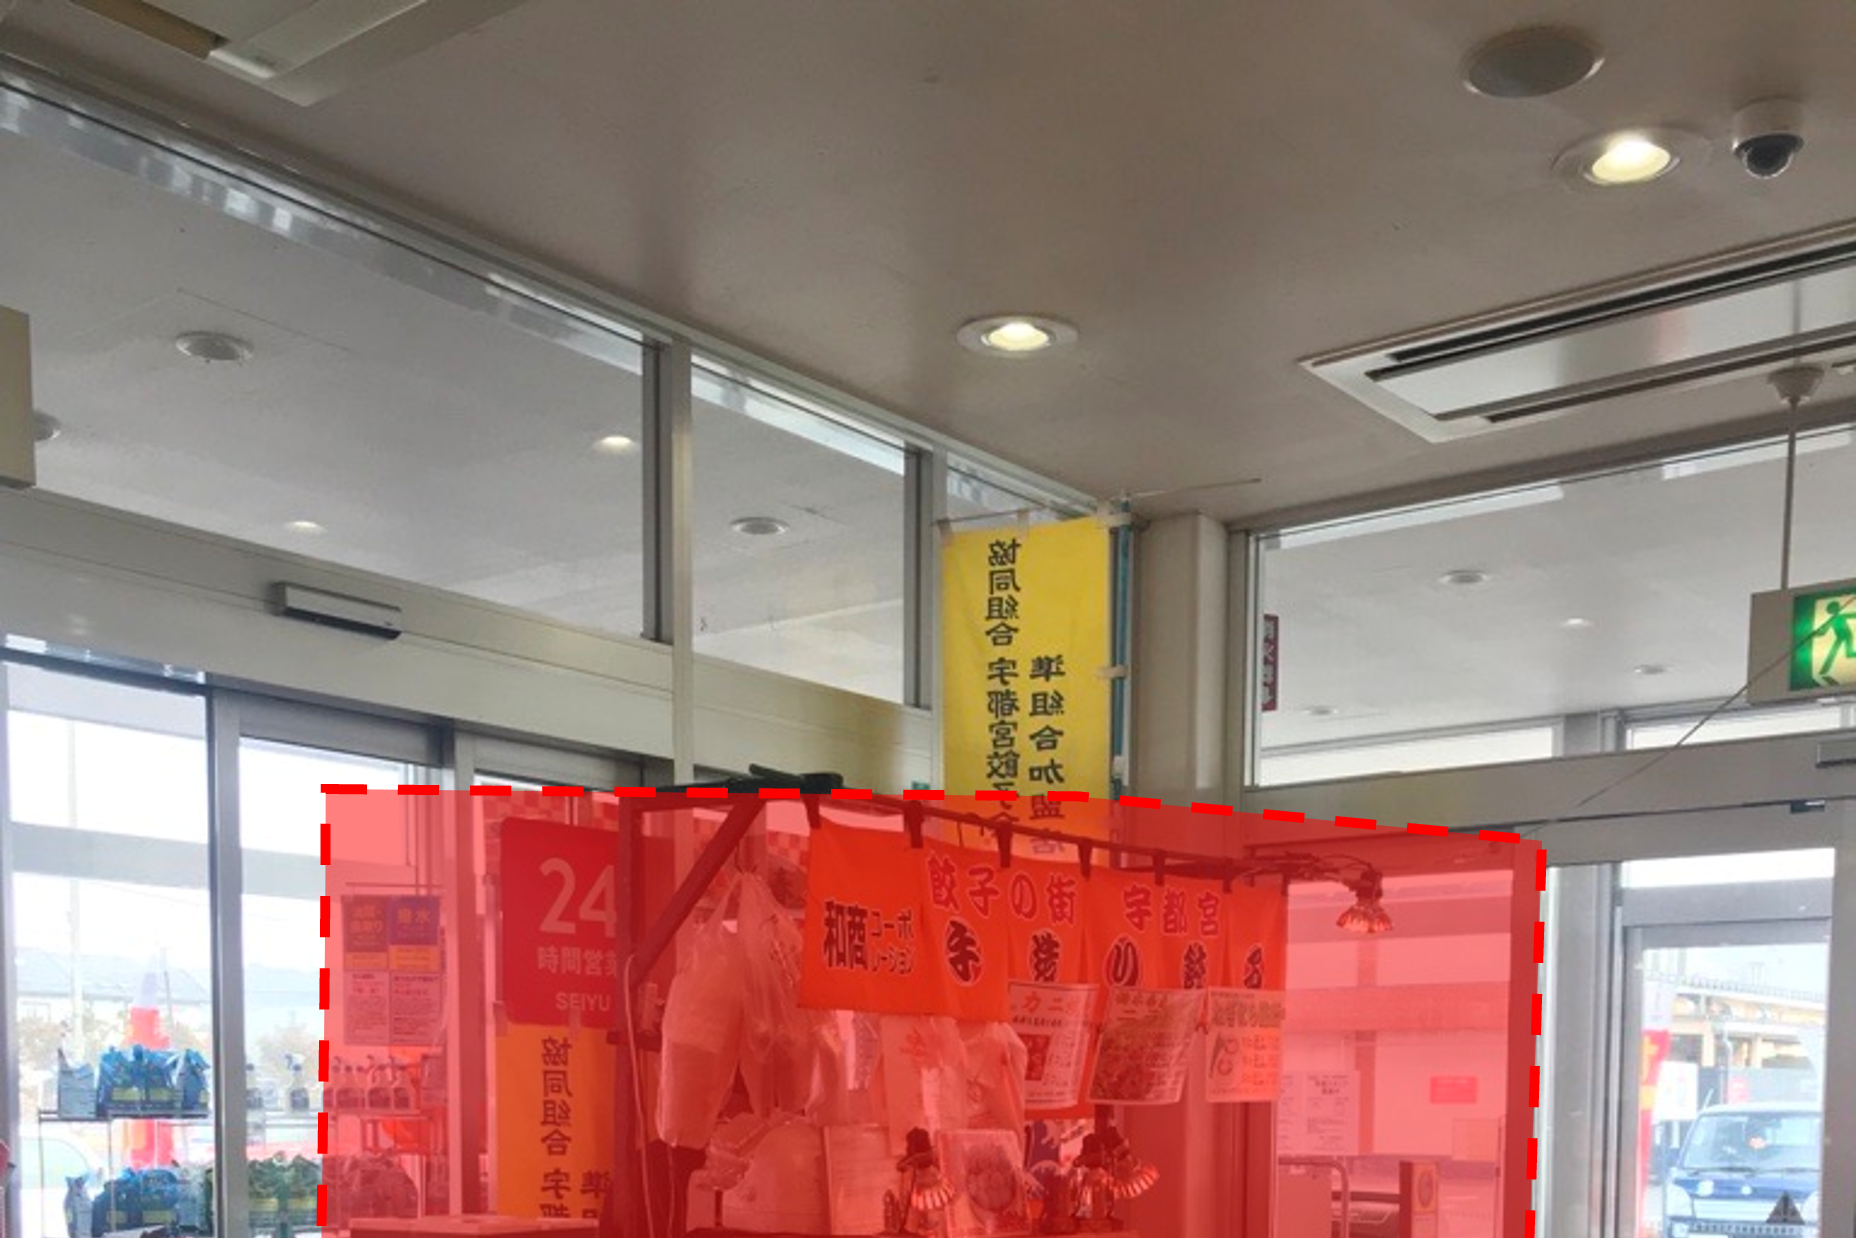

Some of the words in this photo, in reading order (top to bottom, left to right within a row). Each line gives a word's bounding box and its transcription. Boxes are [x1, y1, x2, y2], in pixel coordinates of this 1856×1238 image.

[926, 850, 1077, 926] 餃子の街
[1121, 883, 1221, 938] 宇都宮
[555, 992, 611, 1013] SEIYU
